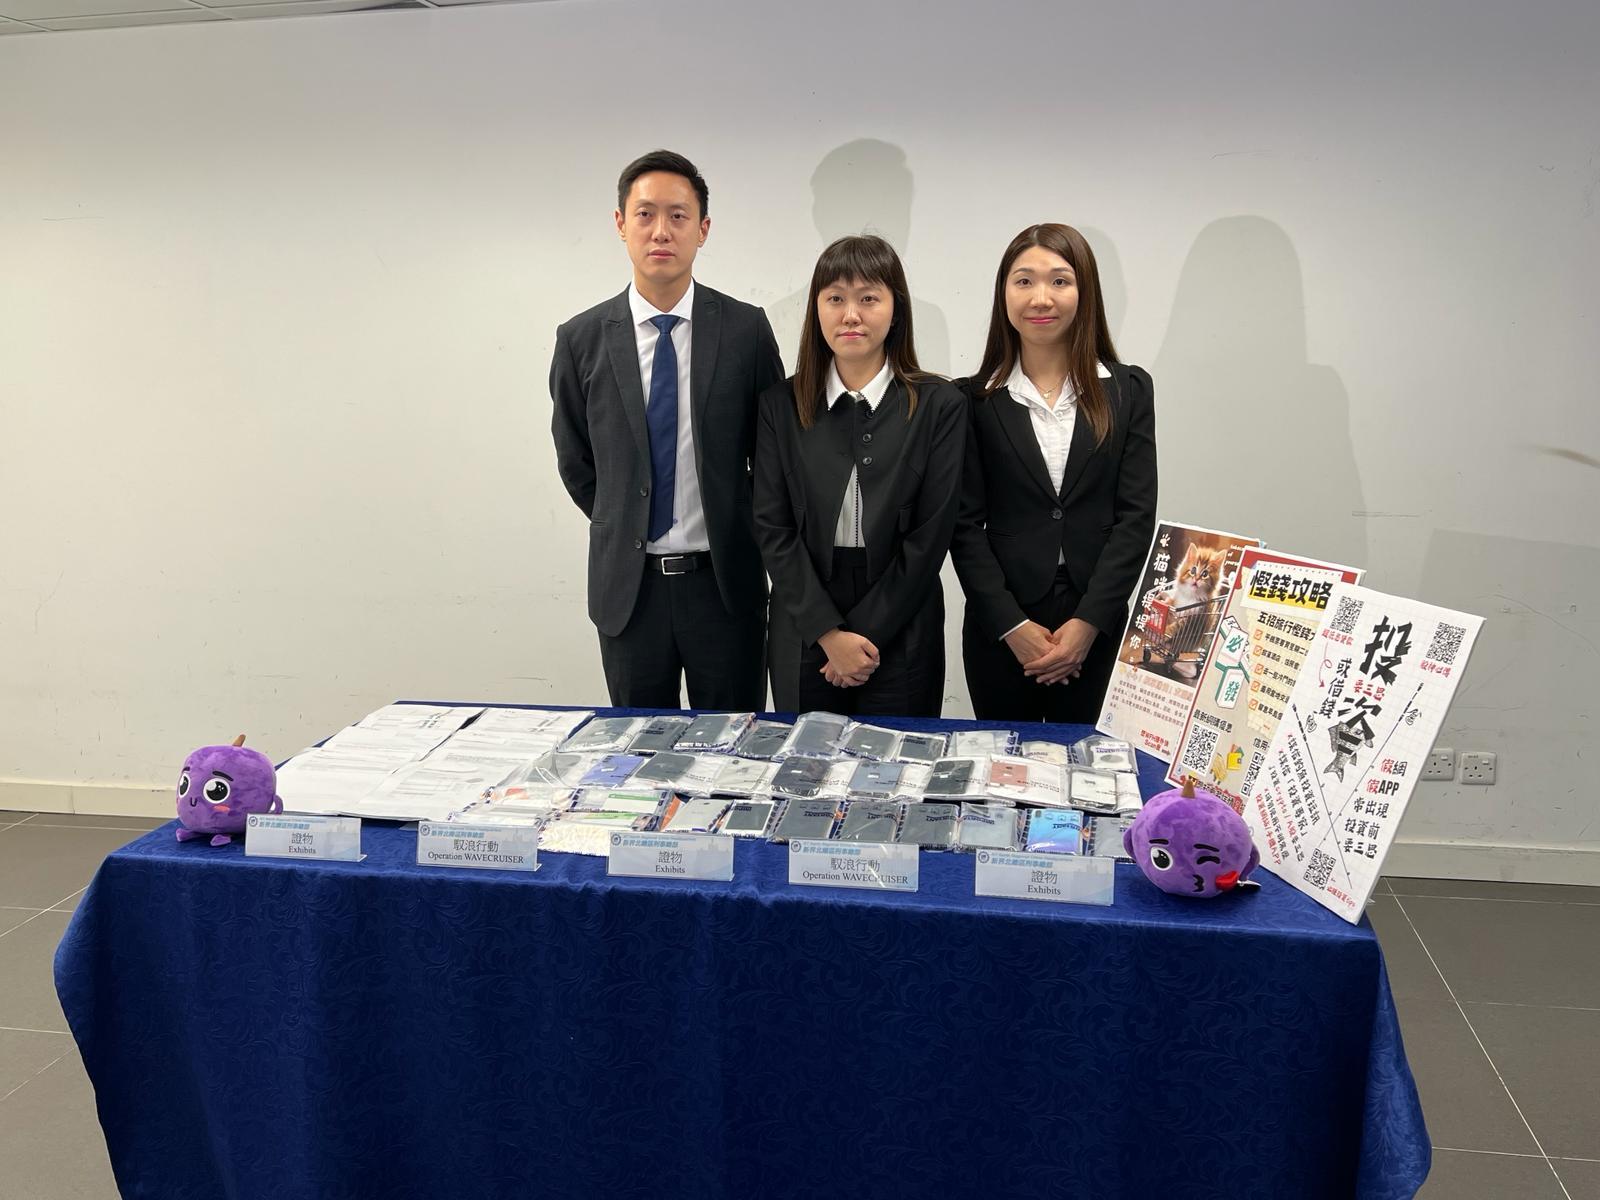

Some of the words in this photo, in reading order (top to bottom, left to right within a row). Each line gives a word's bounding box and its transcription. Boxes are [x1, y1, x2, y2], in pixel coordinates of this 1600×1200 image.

[1250, 570, 1333, 609] 慳錢攻略
[1226, 635, 1244, 653] 必
[1319, 657, 1352, 719] 或借錢
[1353, 679, 1386, 702] 要三思
[1253, 737, 1270, 751] 信用
[1380, 758, 1408, 777] 假網
[1366, 779, 1400, 796] 假APP
[1353, 797, 1390, 818] 常出現
[1344, 818, 1380, 840] 投資前
[291, 832, 314, 845] 證物
[453, 839, 499, 852] 馭浪行動
[288, 846, 316, 854] Exhibits
[1343, 838, 1378, 860] 要三思
[428, 851, 462, 860] Operation
[464, 853, 524, 863] WAVECRUISER
[658, 851, 682, 864] 證物
[655, 865, 685, 874] Exhibits
[830, 857, 880, 872] 馭浪行動
[802, 871, 840, 881] Operation
[1031, 870, 1058, 884] 證物
[1027, 885, 1061, 895] Exhibits
